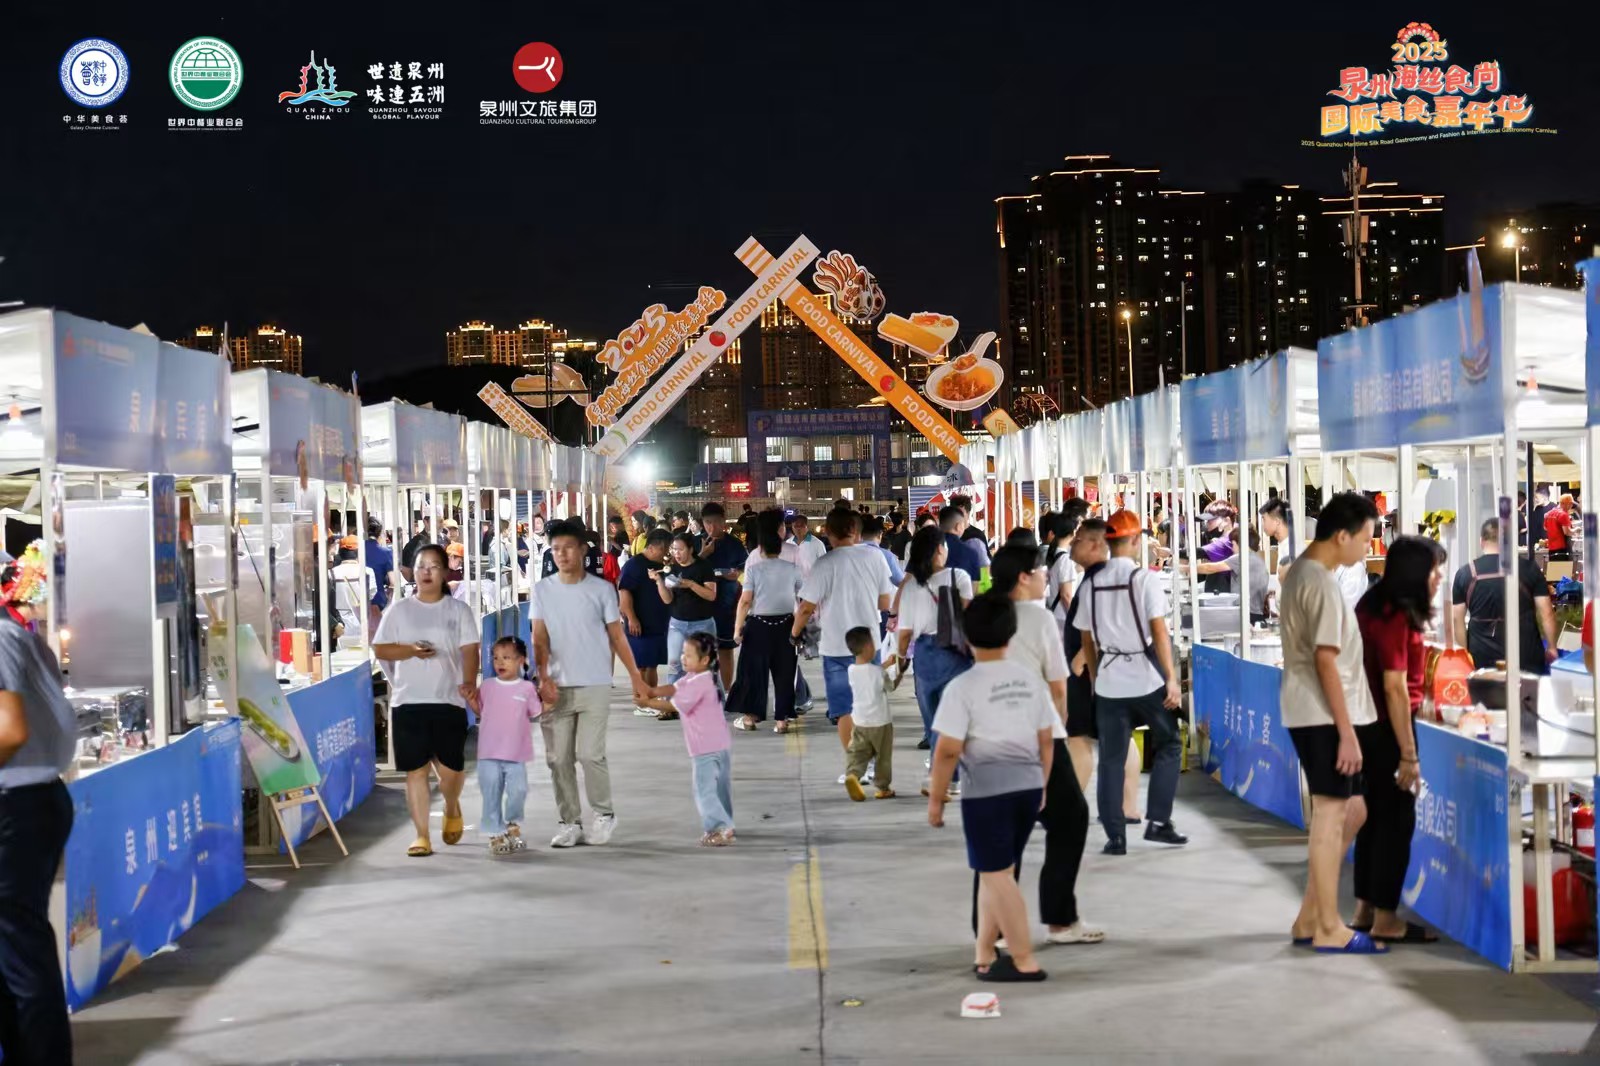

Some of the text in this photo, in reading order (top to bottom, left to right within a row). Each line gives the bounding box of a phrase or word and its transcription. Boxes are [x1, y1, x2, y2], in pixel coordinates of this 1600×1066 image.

[727, 247, 810, 329] FOOD CARNIVAL
[604, 306, 667, 372] 2025
[795, 296, 881, 376] FOOD CARNIVAL
[624, 350, 709, 433] FOOD CARNIVAL
[901, 395, 934, 428] FOOD
